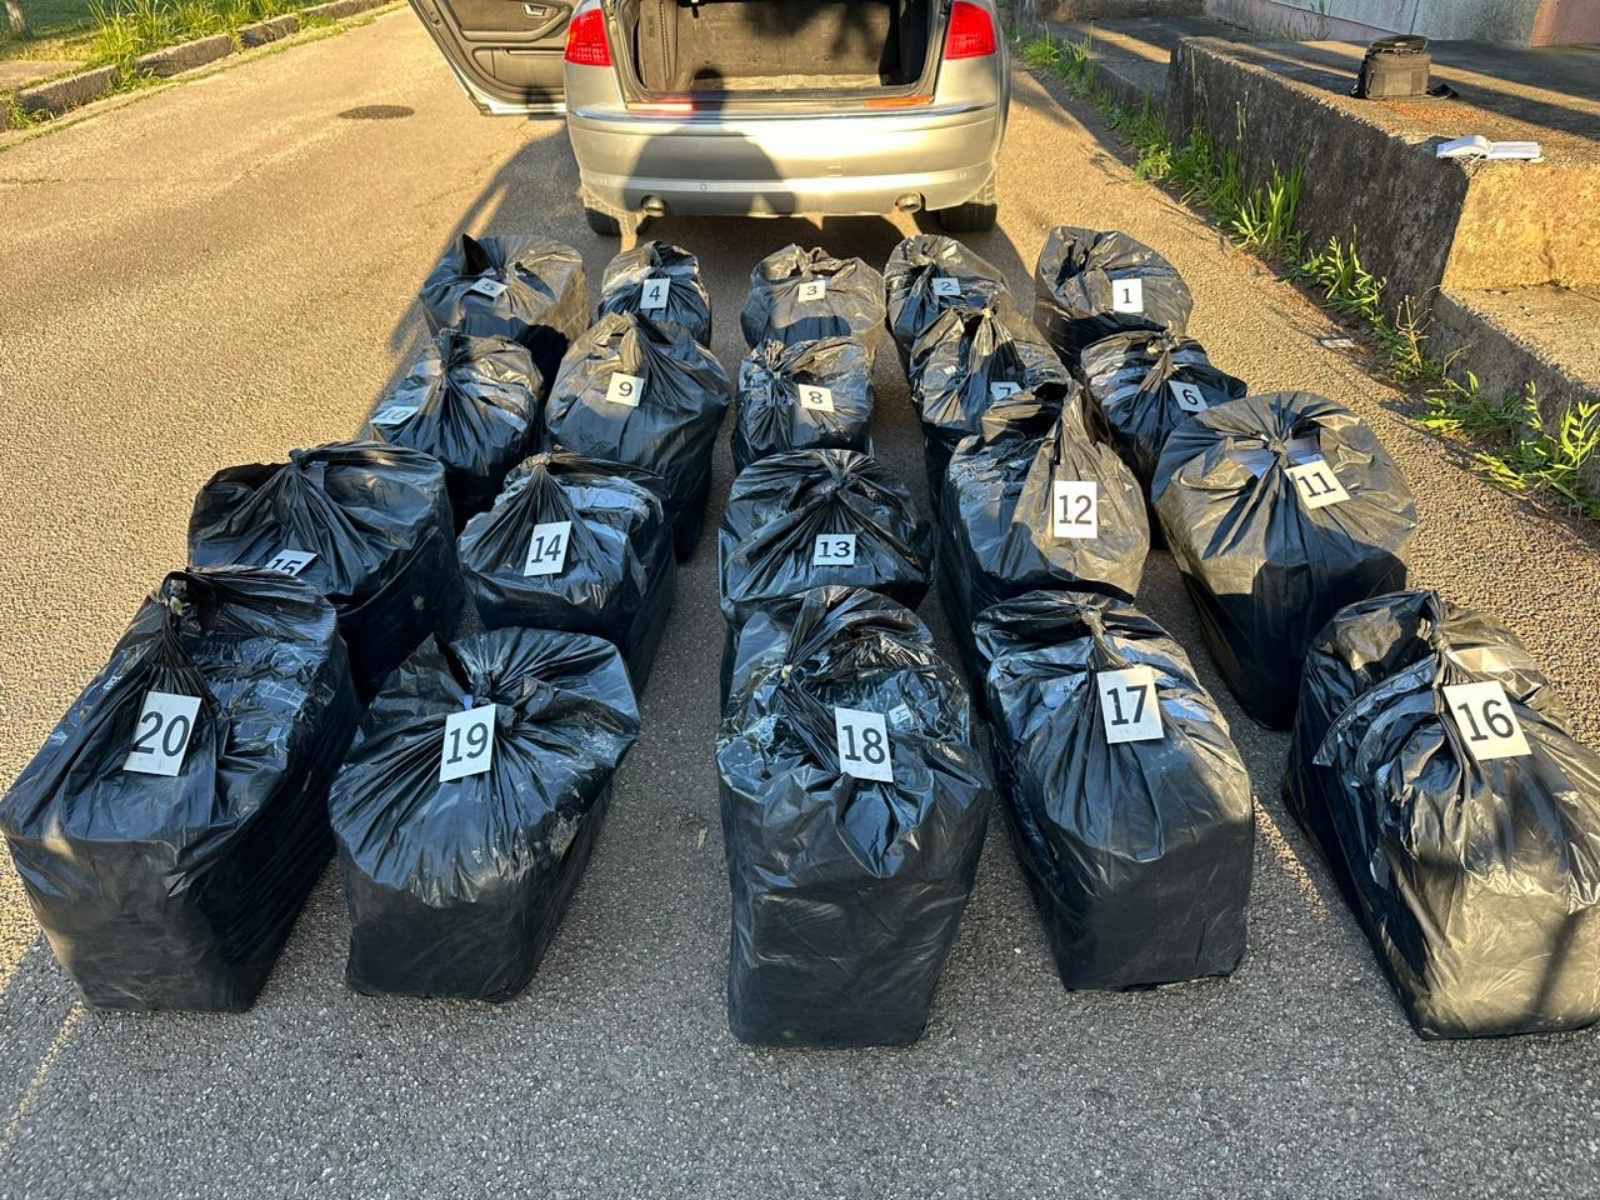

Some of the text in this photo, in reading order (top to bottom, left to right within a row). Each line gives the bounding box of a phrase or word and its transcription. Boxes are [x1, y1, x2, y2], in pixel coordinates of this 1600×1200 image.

[482, 282, 495, 291] 5
[649, 285, 660, 301] 4
[807, 285, 817, 296] 3
[942, 281, 953, 292] 2
[1123, 288, 1132, 304] 1
[618, 381, 633, 397] 9
[999, 386, 1011, 396] 7
[1182, 389, 1198, 405] 6
[809, 391, 823, 404] 8
[1298, 472, 1337, 497] 11
[1058, 495, 1092, 525] 12
[531, 534, 562, 563] 14
[818, 541, 850, 558] 13
[272, 559, 302, 574] 15
[1107, 685, 1148, 725] 17
[1457, 699, 1514, 741] 16
[131, 711, 190, 757] 20
[446, 722, 489, 764] 19
[842, 724, 886, 764] 18
